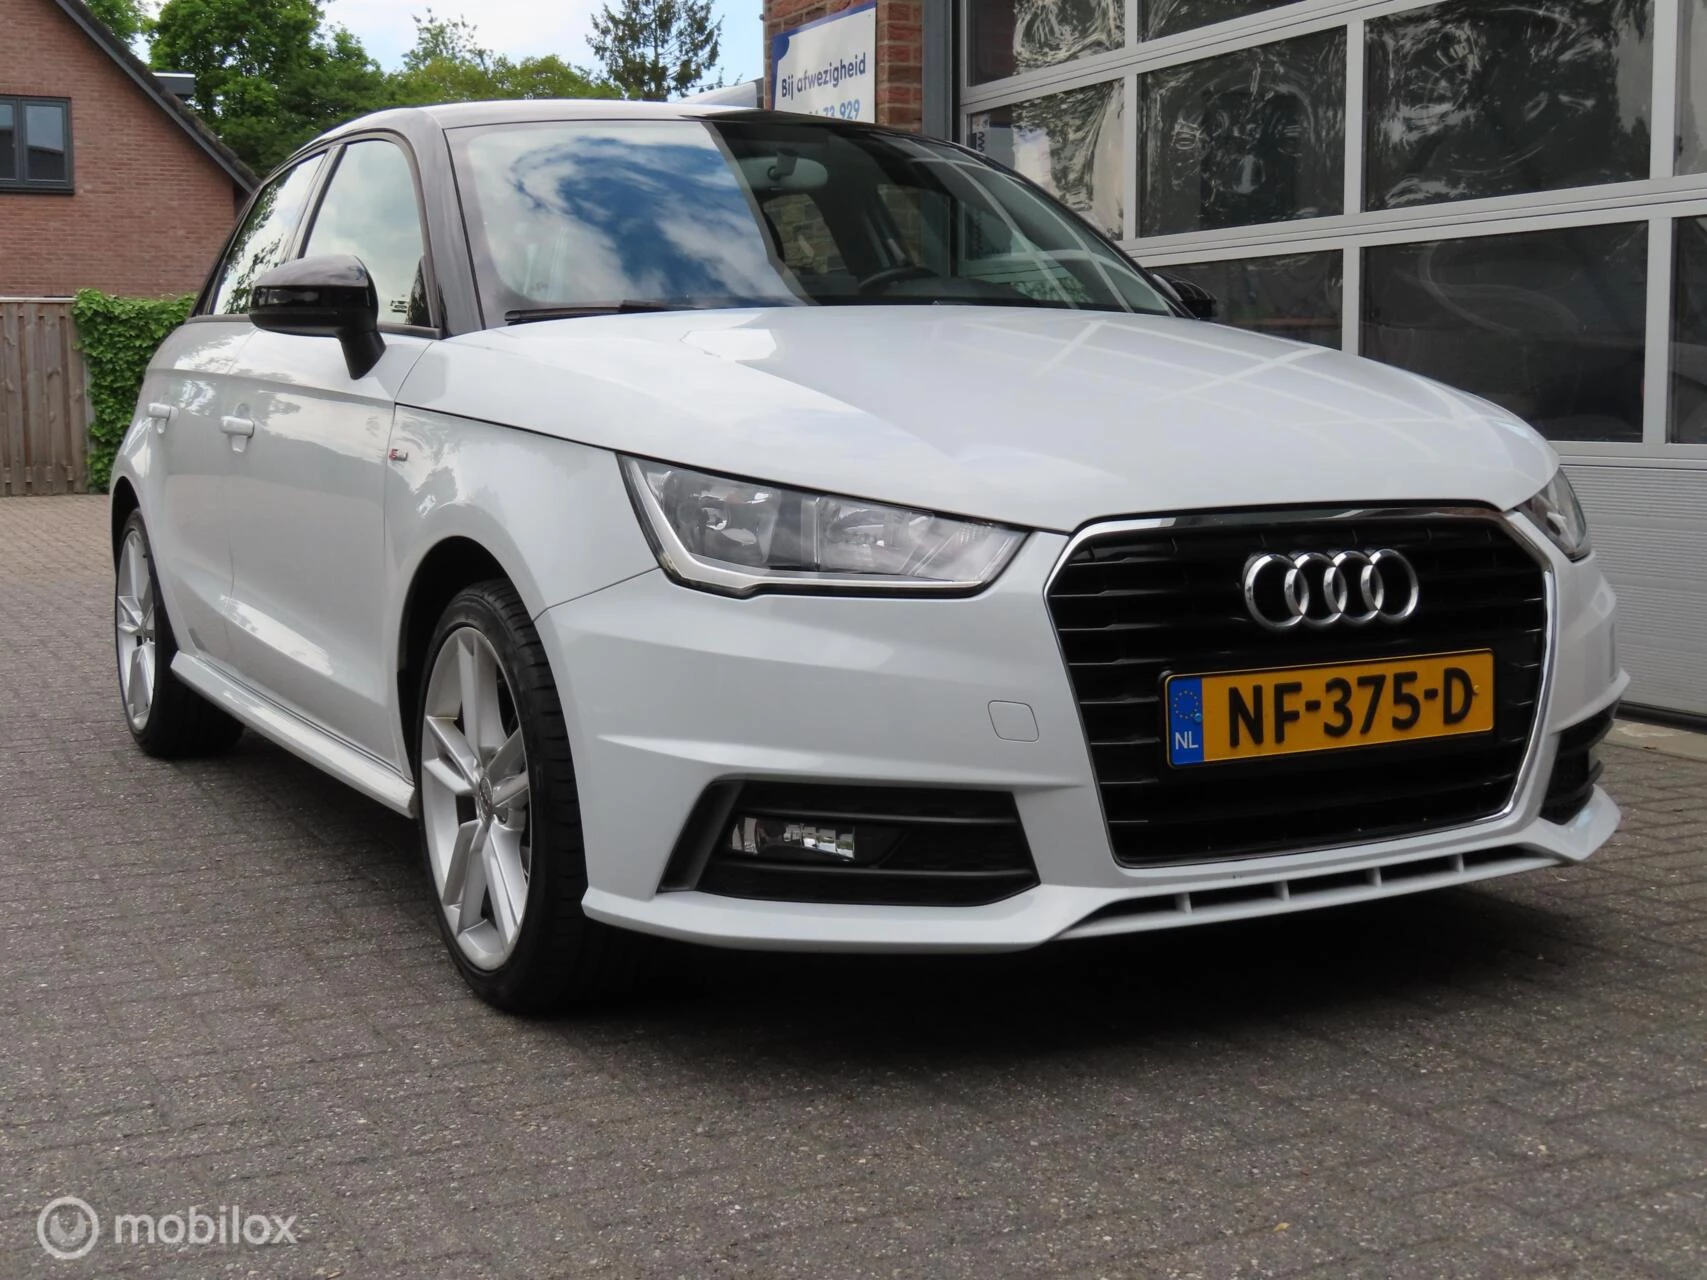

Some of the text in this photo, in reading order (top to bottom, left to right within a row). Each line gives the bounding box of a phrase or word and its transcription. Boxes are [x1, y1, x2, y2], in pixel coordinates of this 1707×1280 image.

[781, 51, 866, 101] Bij afwezigheid
[839, 98, 861, 121] 929
[1228, 667, 1474, 749] NF-375-D
[1175, 730, 1200, 751] NL
